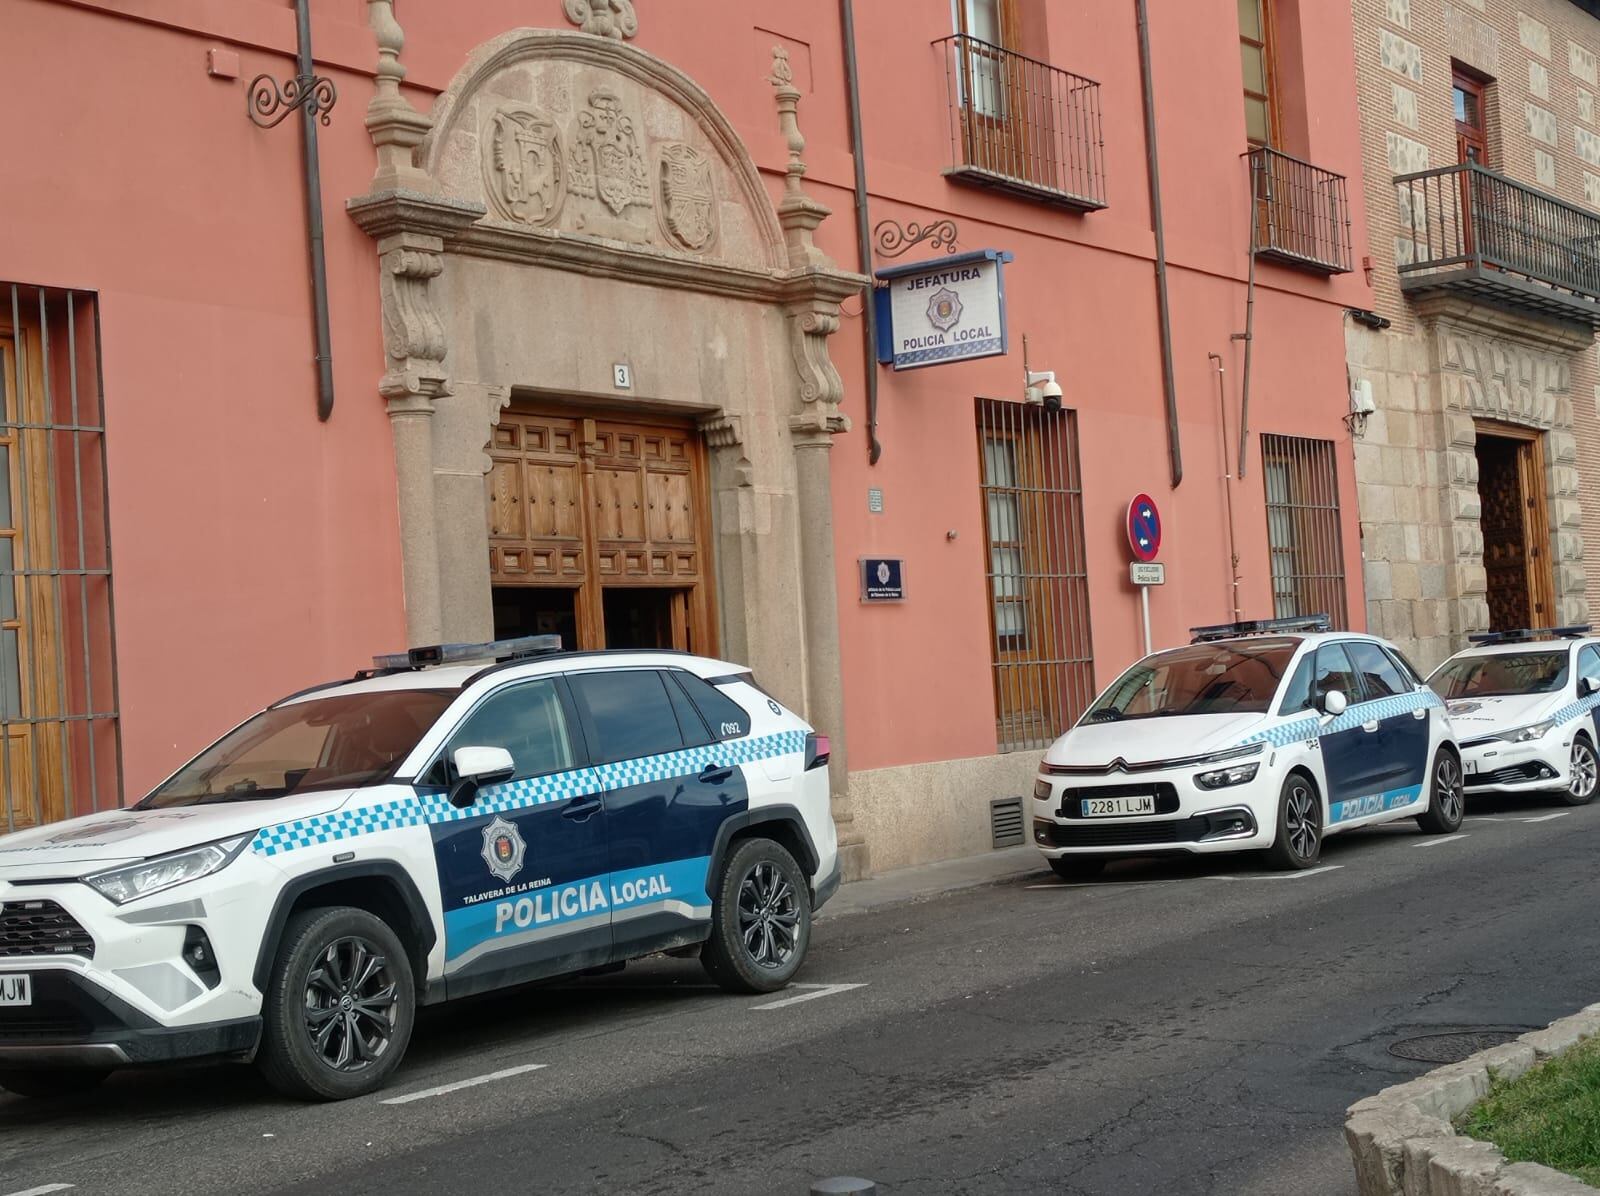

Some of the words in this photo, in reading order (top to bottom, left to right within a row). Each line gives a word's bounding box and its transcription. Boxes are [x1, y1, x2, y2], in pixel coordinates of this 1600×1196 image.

[907, 268, 981, 291] JEFATURA
[903, 334, 945, 350] POLICIA
[953, 326, 992, 342] LOCAL
[618, 368, 625, 384] 3
[726, 721, 741, 735] 092
[1463, 762, 1472, 773] Y
[1091, 800, 1121, 814] 2281
[1126, 798, 1151, 812] LJM
[1339, 794, 1384, 820] POLICIA
[1389, 794, 1411, 809] LOCAL
[463, 889, 504, 904] TALAVERA
[505, 885, 516, 895] DE
[517, 882, 528, 892] LA
[528, 877, 552, 889] REINA
[495, 881, 608, 933] POLICIA
[611, 874, 672, 905] LOCAL
